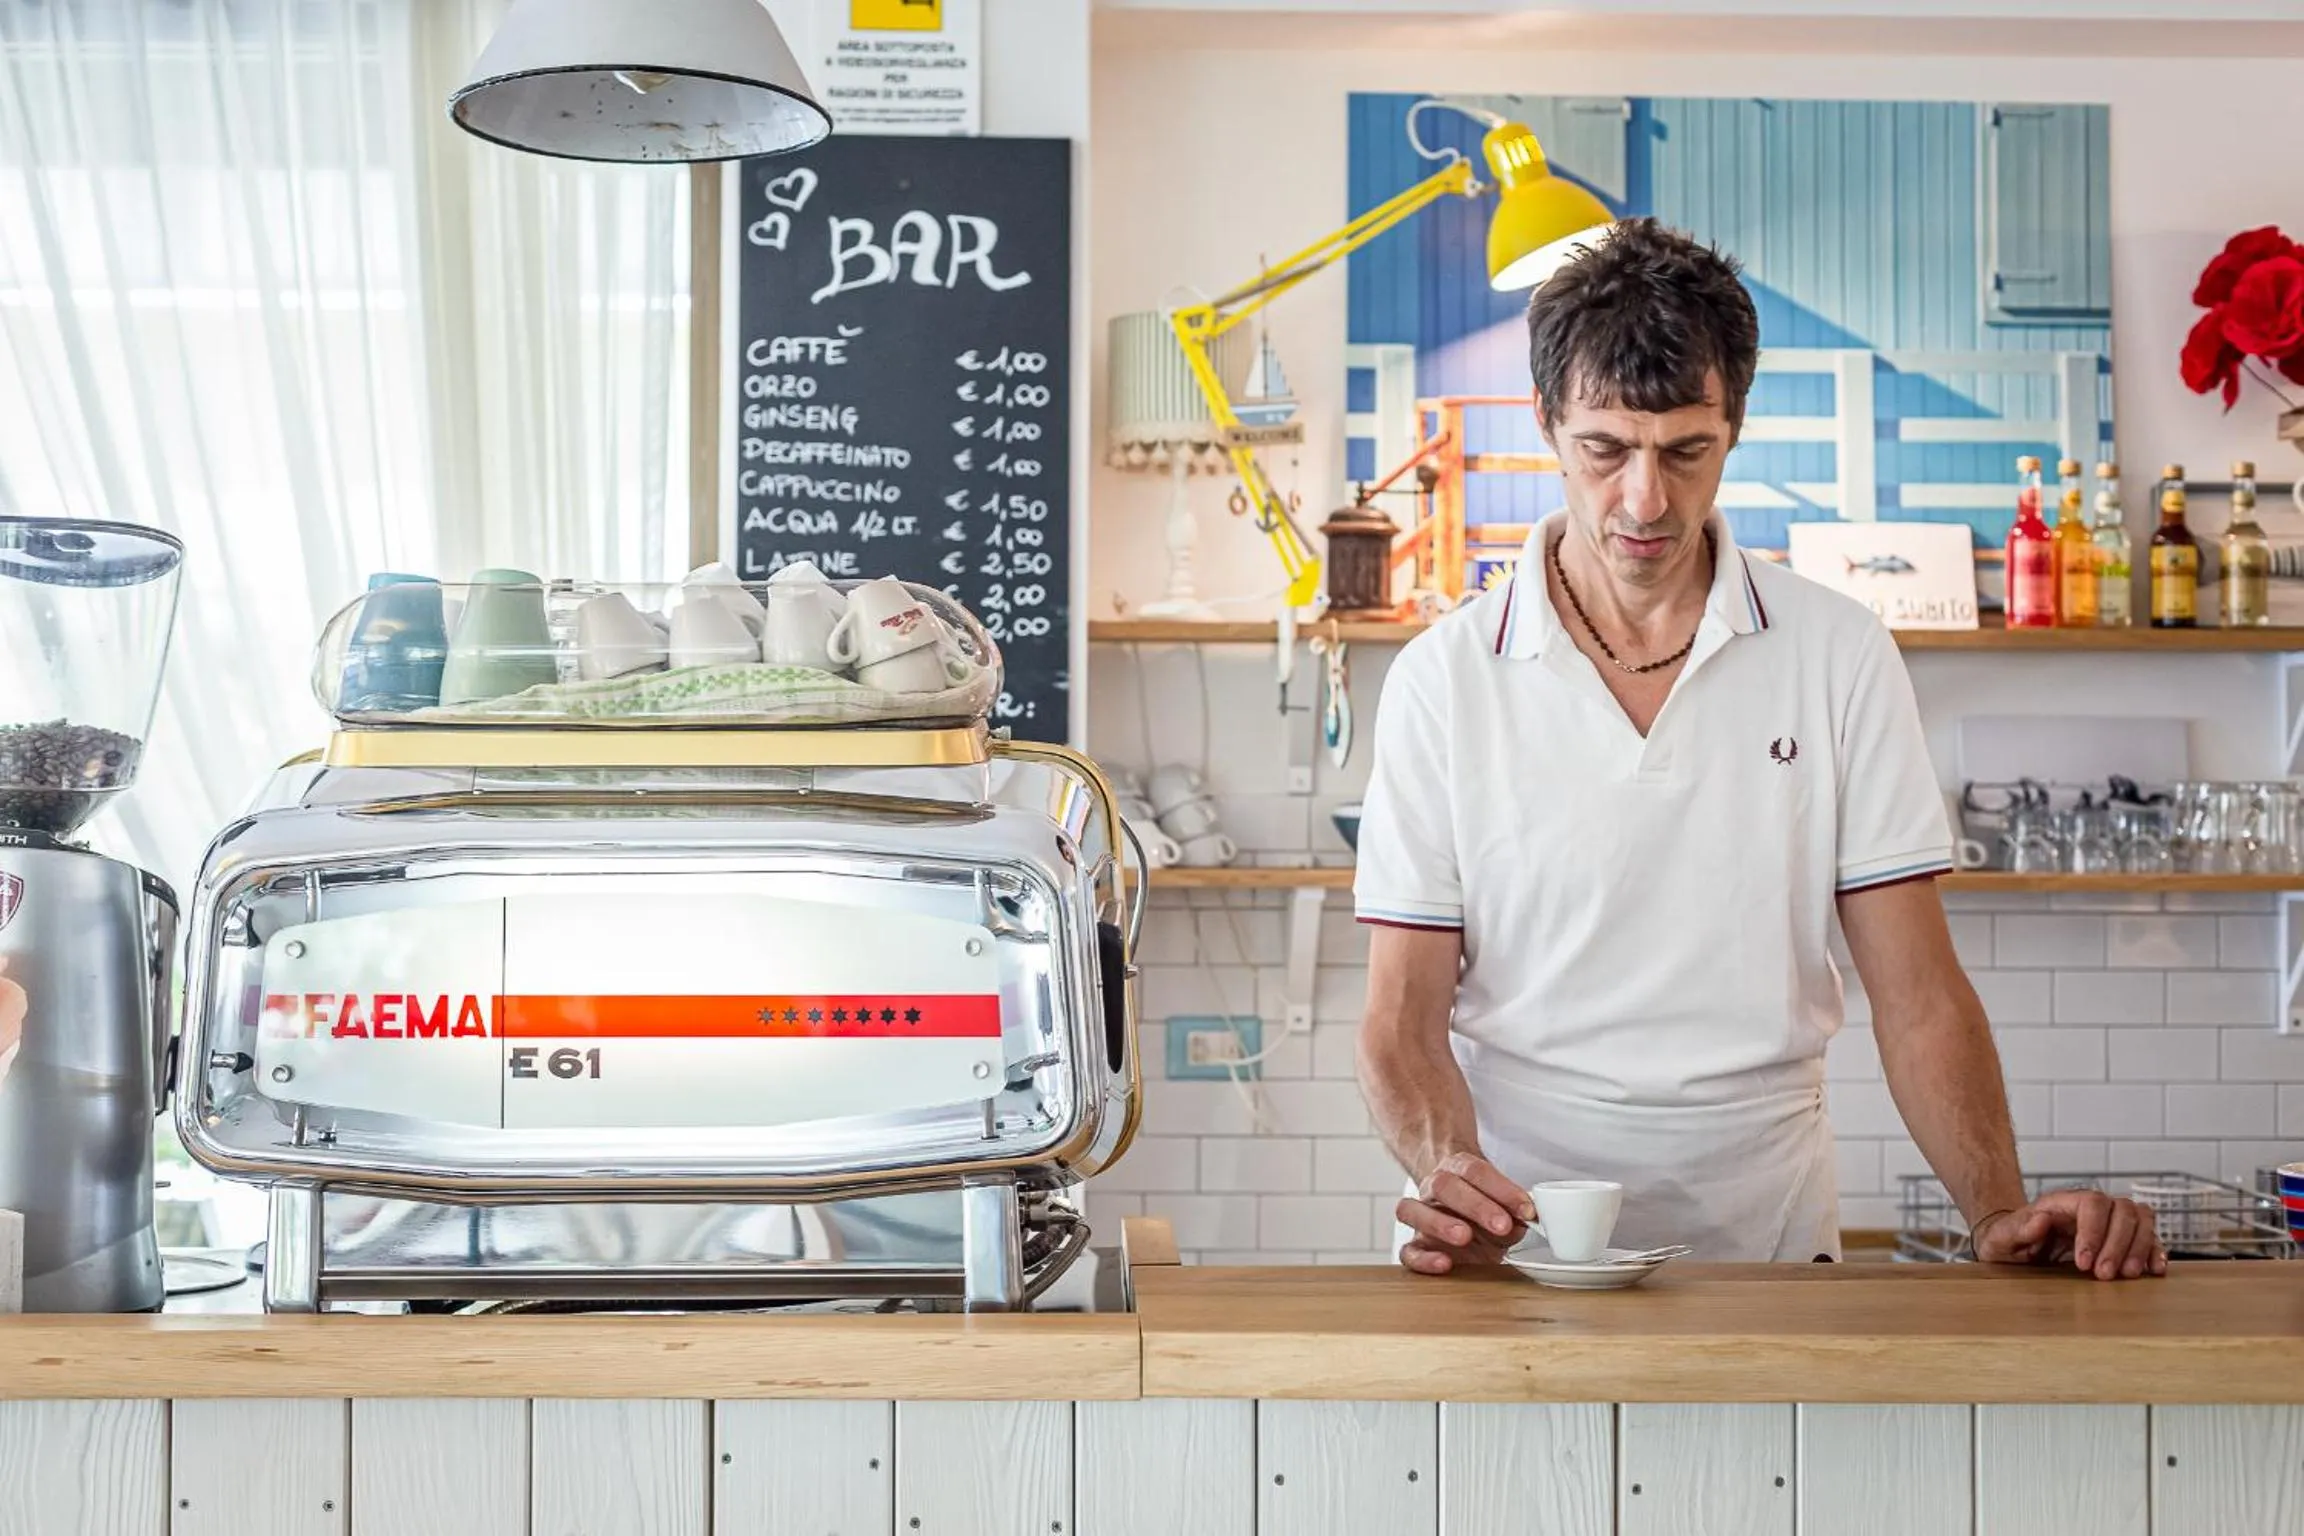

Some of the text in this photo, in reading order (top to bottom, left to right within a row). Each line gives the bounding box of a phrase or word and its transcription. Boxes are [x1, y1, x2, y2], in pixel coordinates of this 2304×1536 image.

[811, 209, 1032, 304] BAR
[743, 403, 859, 436] GINSENG
[742, 437, 911, 470] DECAFFEINATO
[739, 470, 901, 503] CAPPUCCINO
[980, 493, 1048, 522] 1,50
[743, 507, 839, 535] ACQUA
[980, 552, 1052, 579] 2,50
[304, 994, 490, 1040] FAEMA
[508, 1047, 601, 1079] E 61
